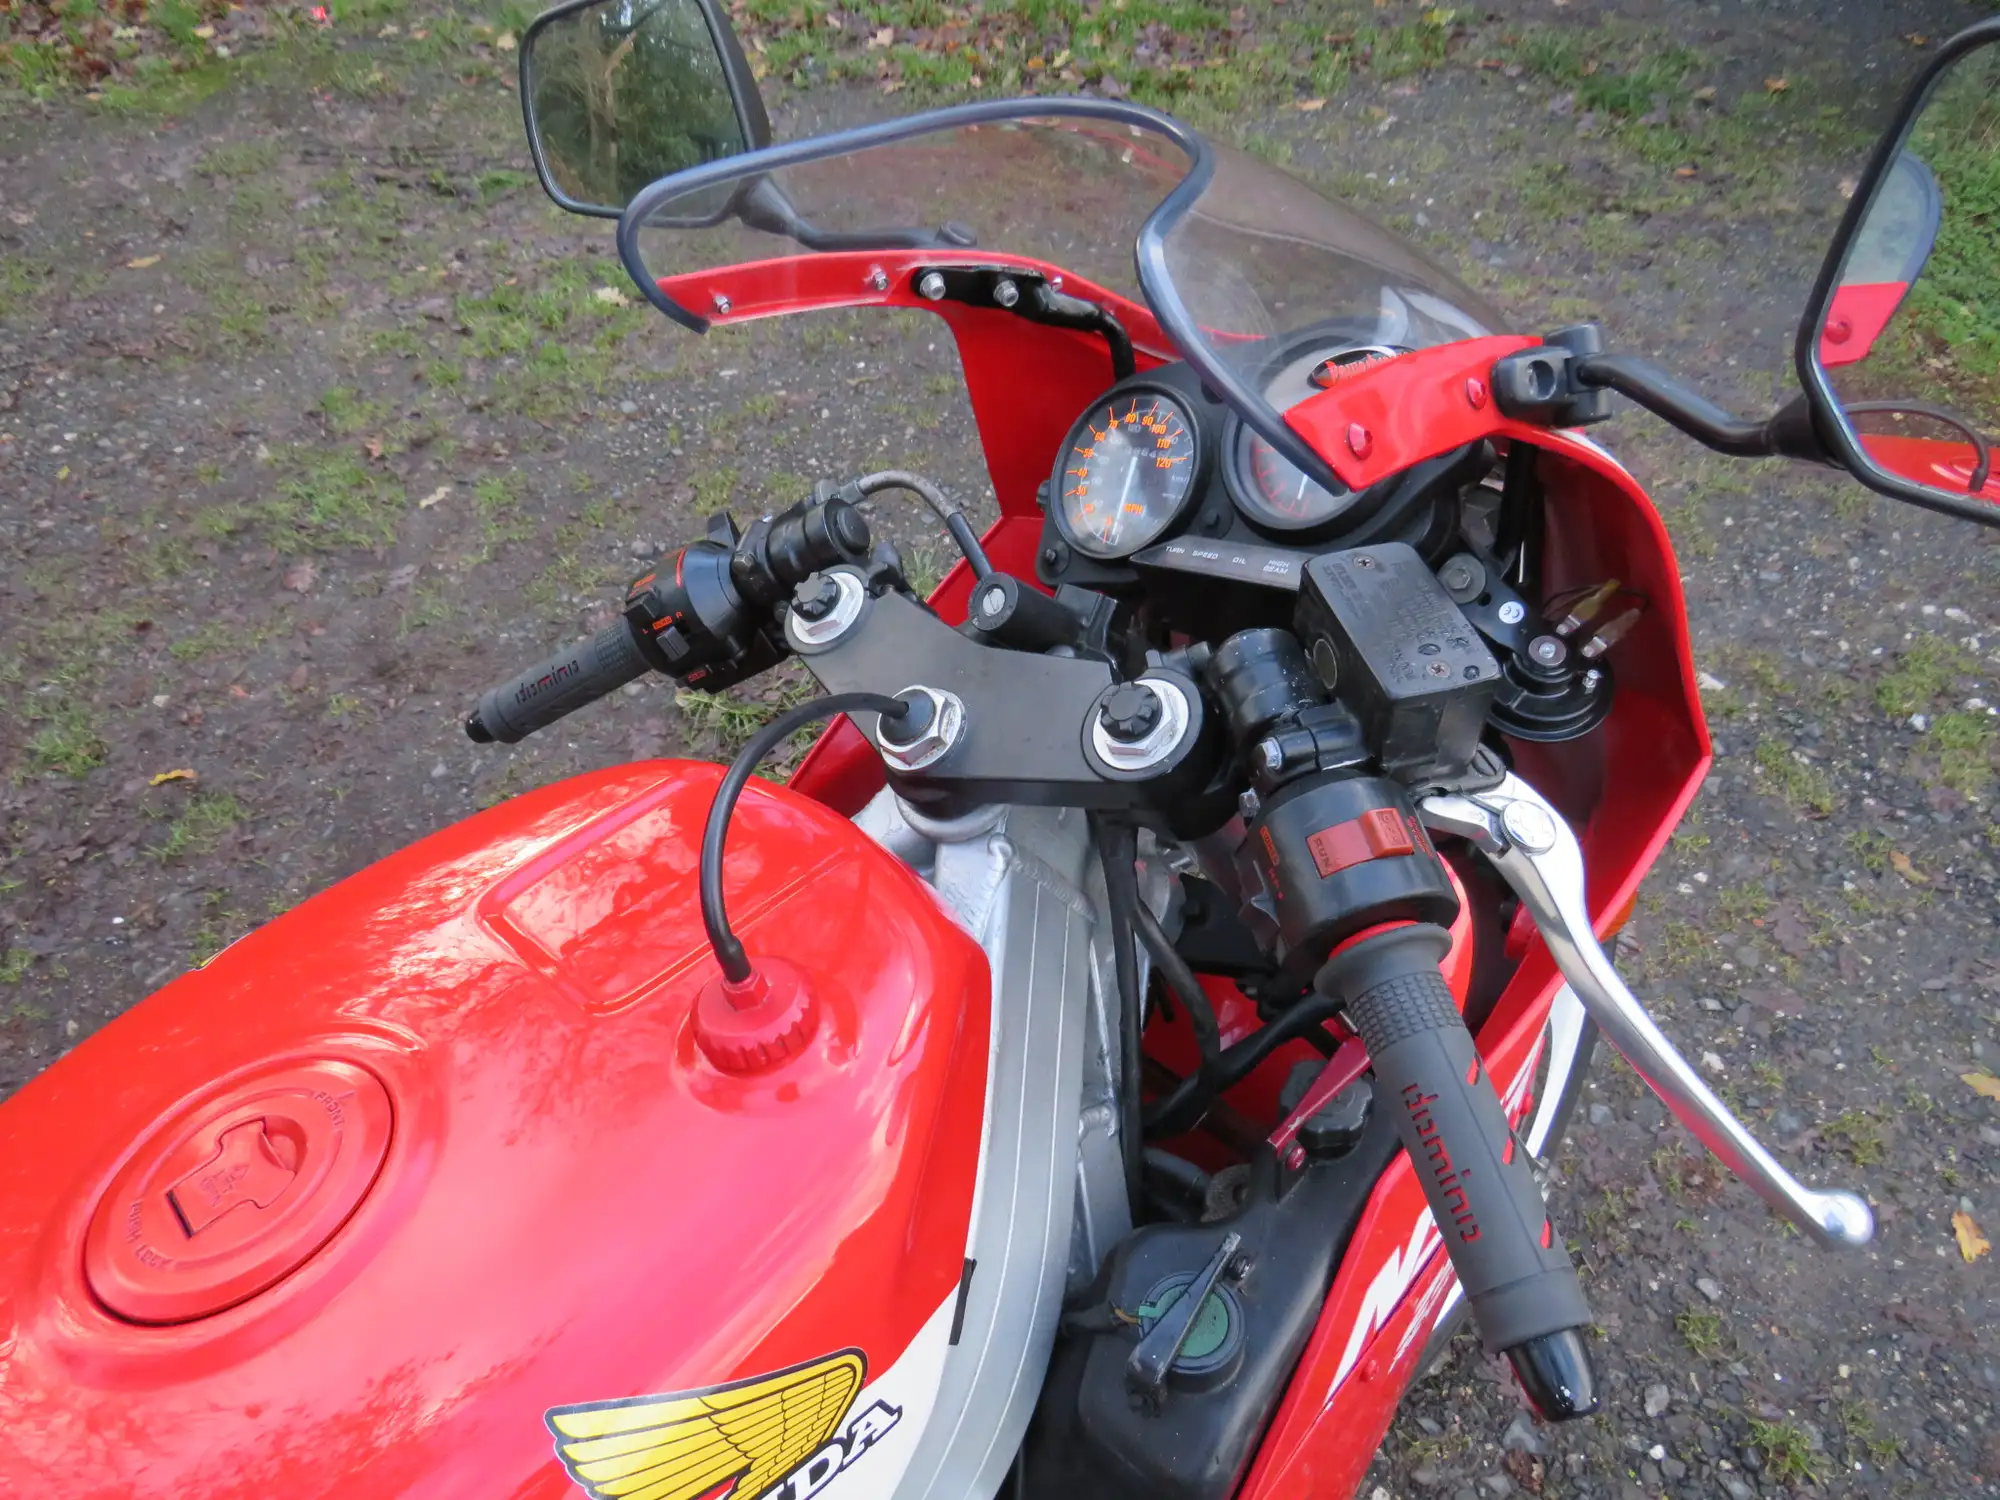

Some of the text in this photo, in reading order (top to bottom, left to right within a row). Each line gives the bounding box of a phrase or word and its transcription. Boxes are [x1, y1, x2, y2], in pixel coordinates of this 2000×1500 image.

[1124, 414, 1136, 424] 80
[1142, 416, 1154, 427] 90
[1151, 424, 1167, 435] 100
[1156, 437, 1171, 449] 110
[1083, 448, 1095, 459] 50
[1155, 456, 1173, 468] 120
[1077, 468, 1088, 479] 40
[1076, 486, 1087, 497] 30
[1123, 503, 1145, 515] MPH
[1165, 545, 1247, 566] TURN SPEED OIL
[1267, 559, 1291, 569] HIGH
[1262, 566, 1290, 576] BEAM
[1313, 837, 1333, 869] RUN
[313, 1091, 346, 1127] FRONT
[1401, 1082, 1482, 1242] domino
[134, 1244, 175, 1271] LOCK
